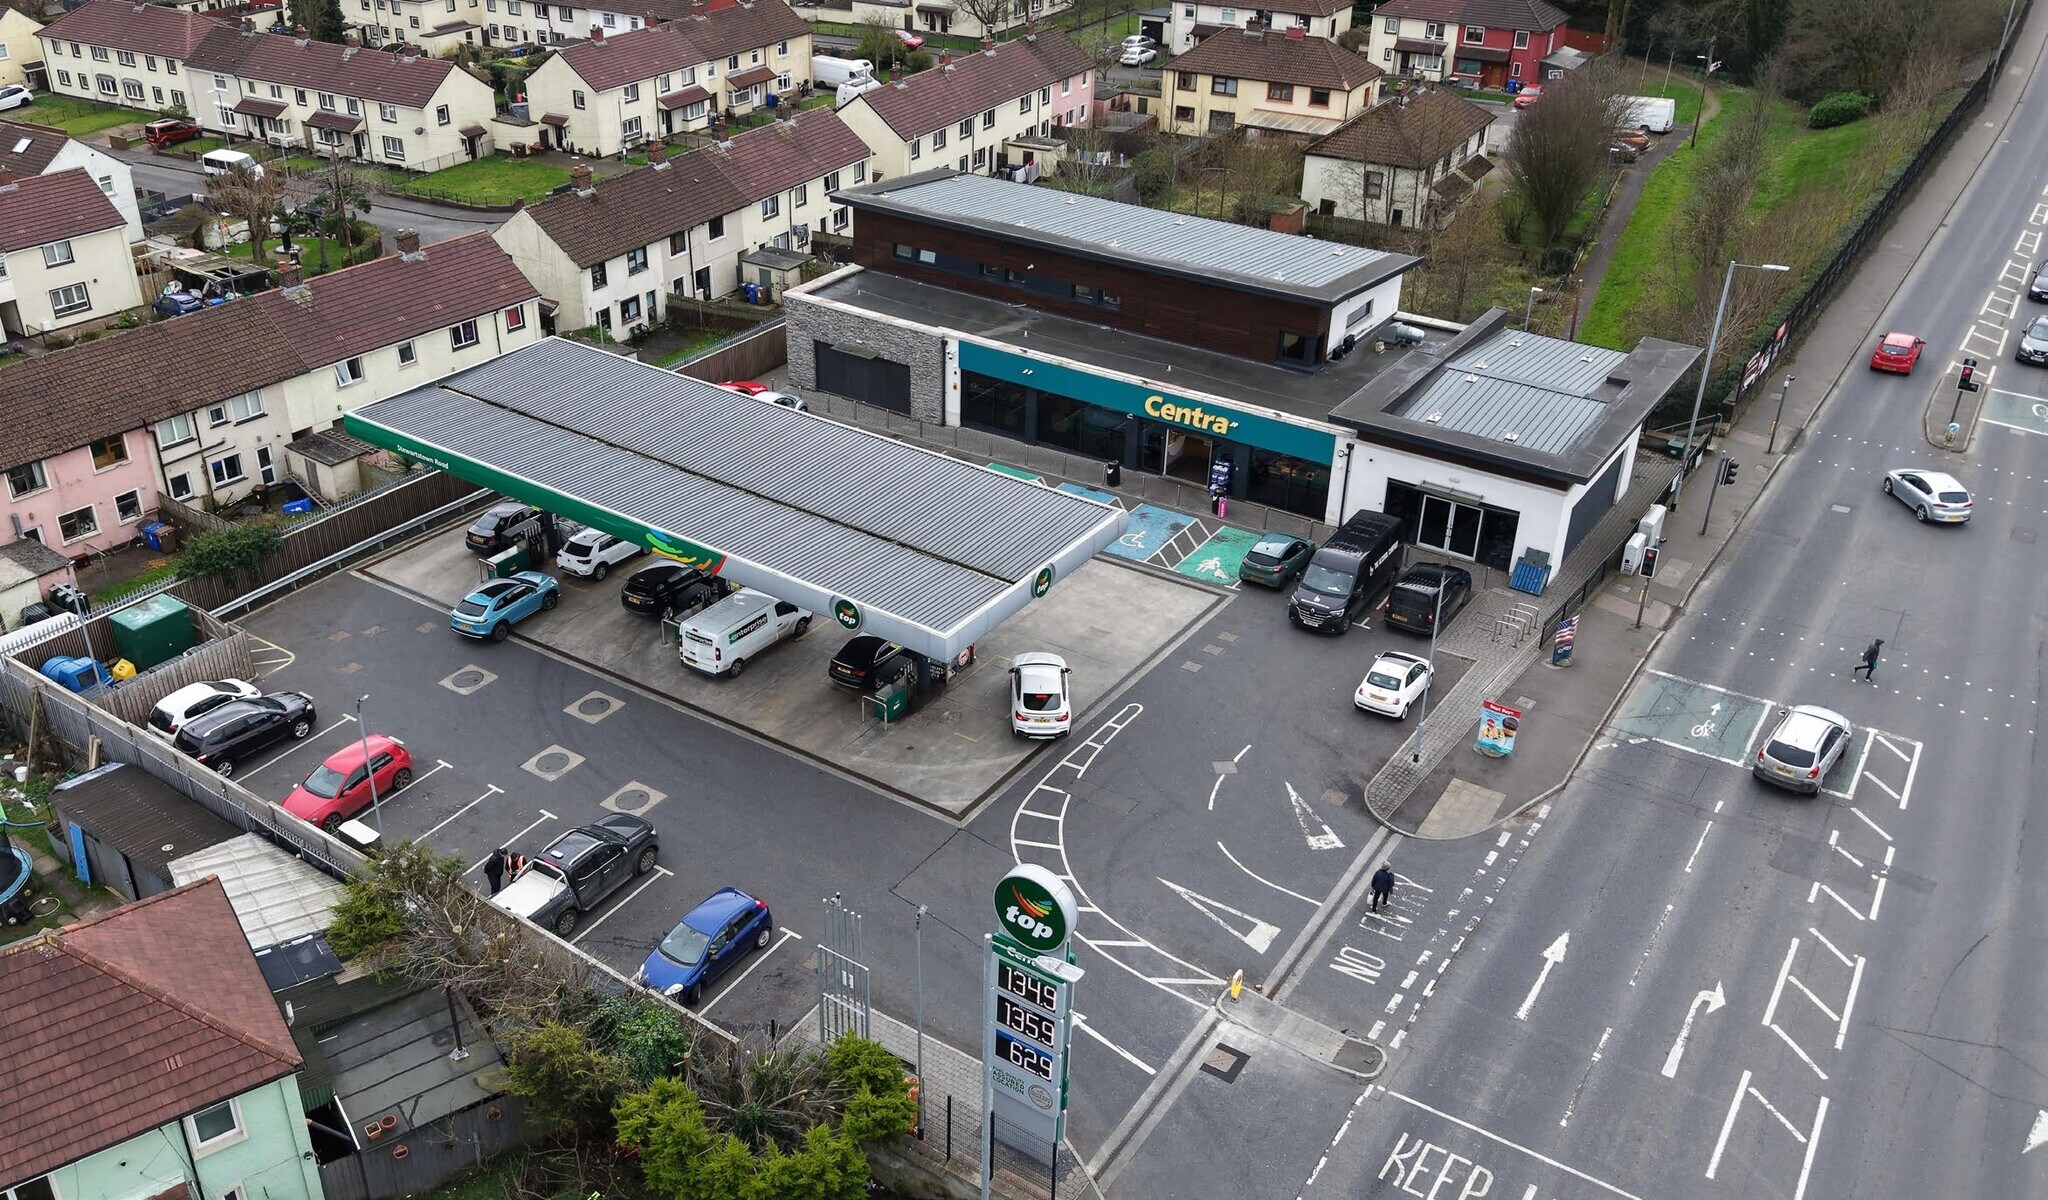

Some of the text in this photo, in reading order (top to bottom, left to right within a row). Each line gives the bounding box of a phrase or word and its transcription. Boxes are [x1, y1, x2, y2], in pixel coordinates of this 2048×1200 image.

[1144, 395, 1230, 434] Centra
[1037, 581, 1049, 594] top
[729, 615, 768, 642] enterprise
[839, 612, 856, 625] top
[1006, 904, 1053, 939] top
[1329, 946, 1386, 985] NO
[1006, 966, 1057, 1011] 134.9
[1004, 1002, 1055, 1046] 135.9
[1010, 1041, 1053, 1081] 62.9
[992, 1070, 1025, 1089] ASSURED
[992, 1075, 1024, 1095] LOCATION
